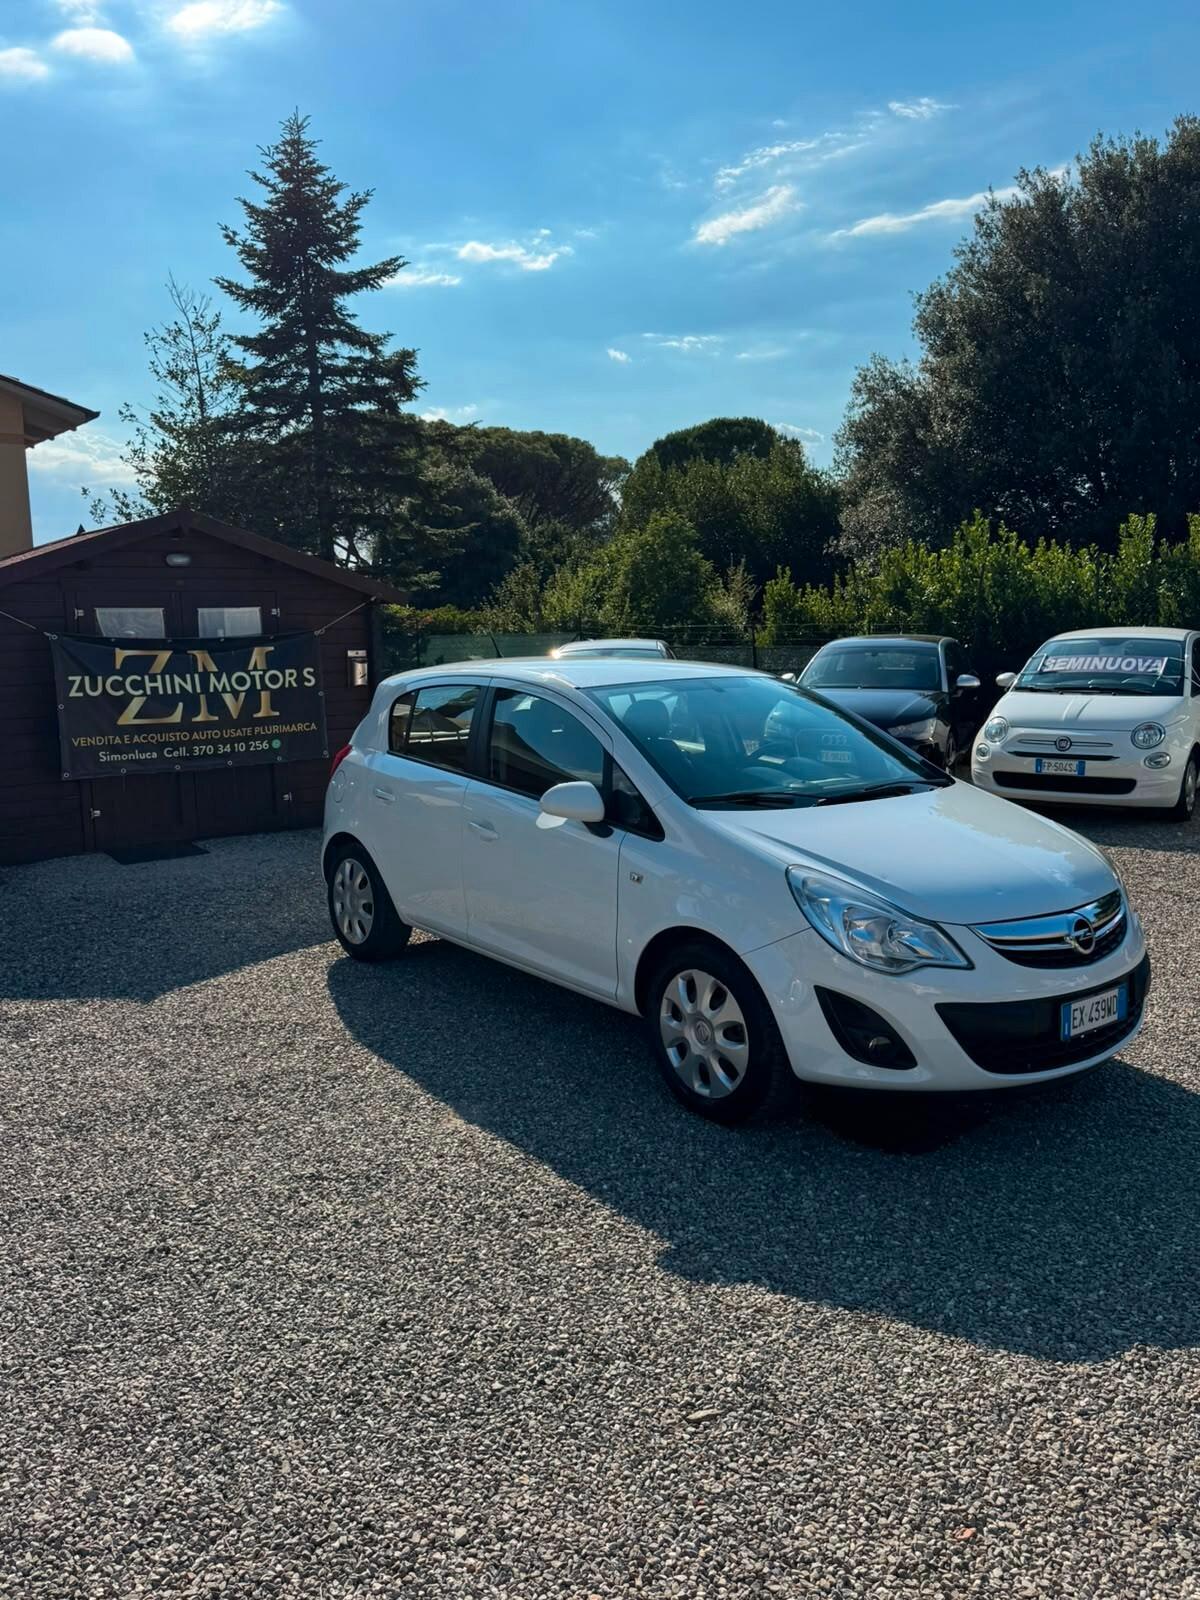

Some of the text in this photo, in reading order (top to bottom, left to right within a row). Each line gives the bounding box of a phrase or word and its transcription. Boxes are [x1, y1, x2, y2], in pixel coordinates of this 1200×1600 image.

[1042, 656, 1163, 673] SEMINUOVA
[67, 667, 316, 698] ZUCCHINI MOTORS
[114, 646, 280, 726] ZM
[71, 722, 318, 747] VENDITA E ACQUISTO AUTO USATE PLURIMARCA
[98, 740, 270, 762] Simonluca Cell. 370 34 10 256
